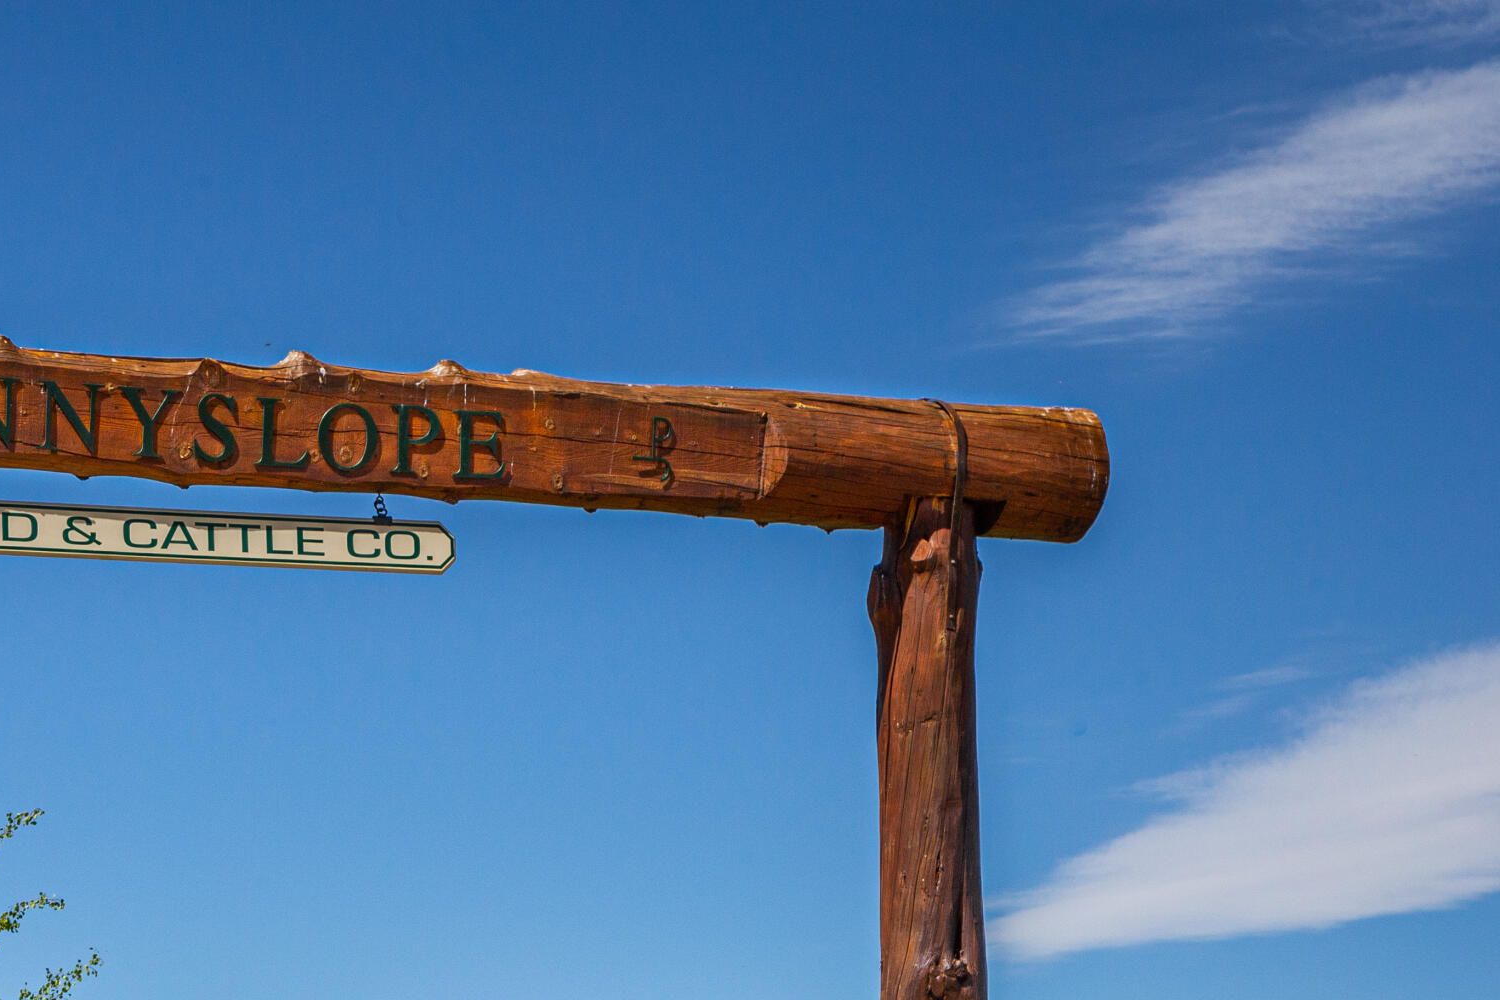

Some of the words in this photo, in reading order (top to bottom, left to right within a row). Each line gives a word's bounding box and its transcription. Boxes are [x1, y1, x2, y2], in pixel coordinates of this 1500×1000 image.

[62, 515, 102, 546] &
[122, 518, 325, 556] CATTLE
[346, 529, 434, 561] CO.
